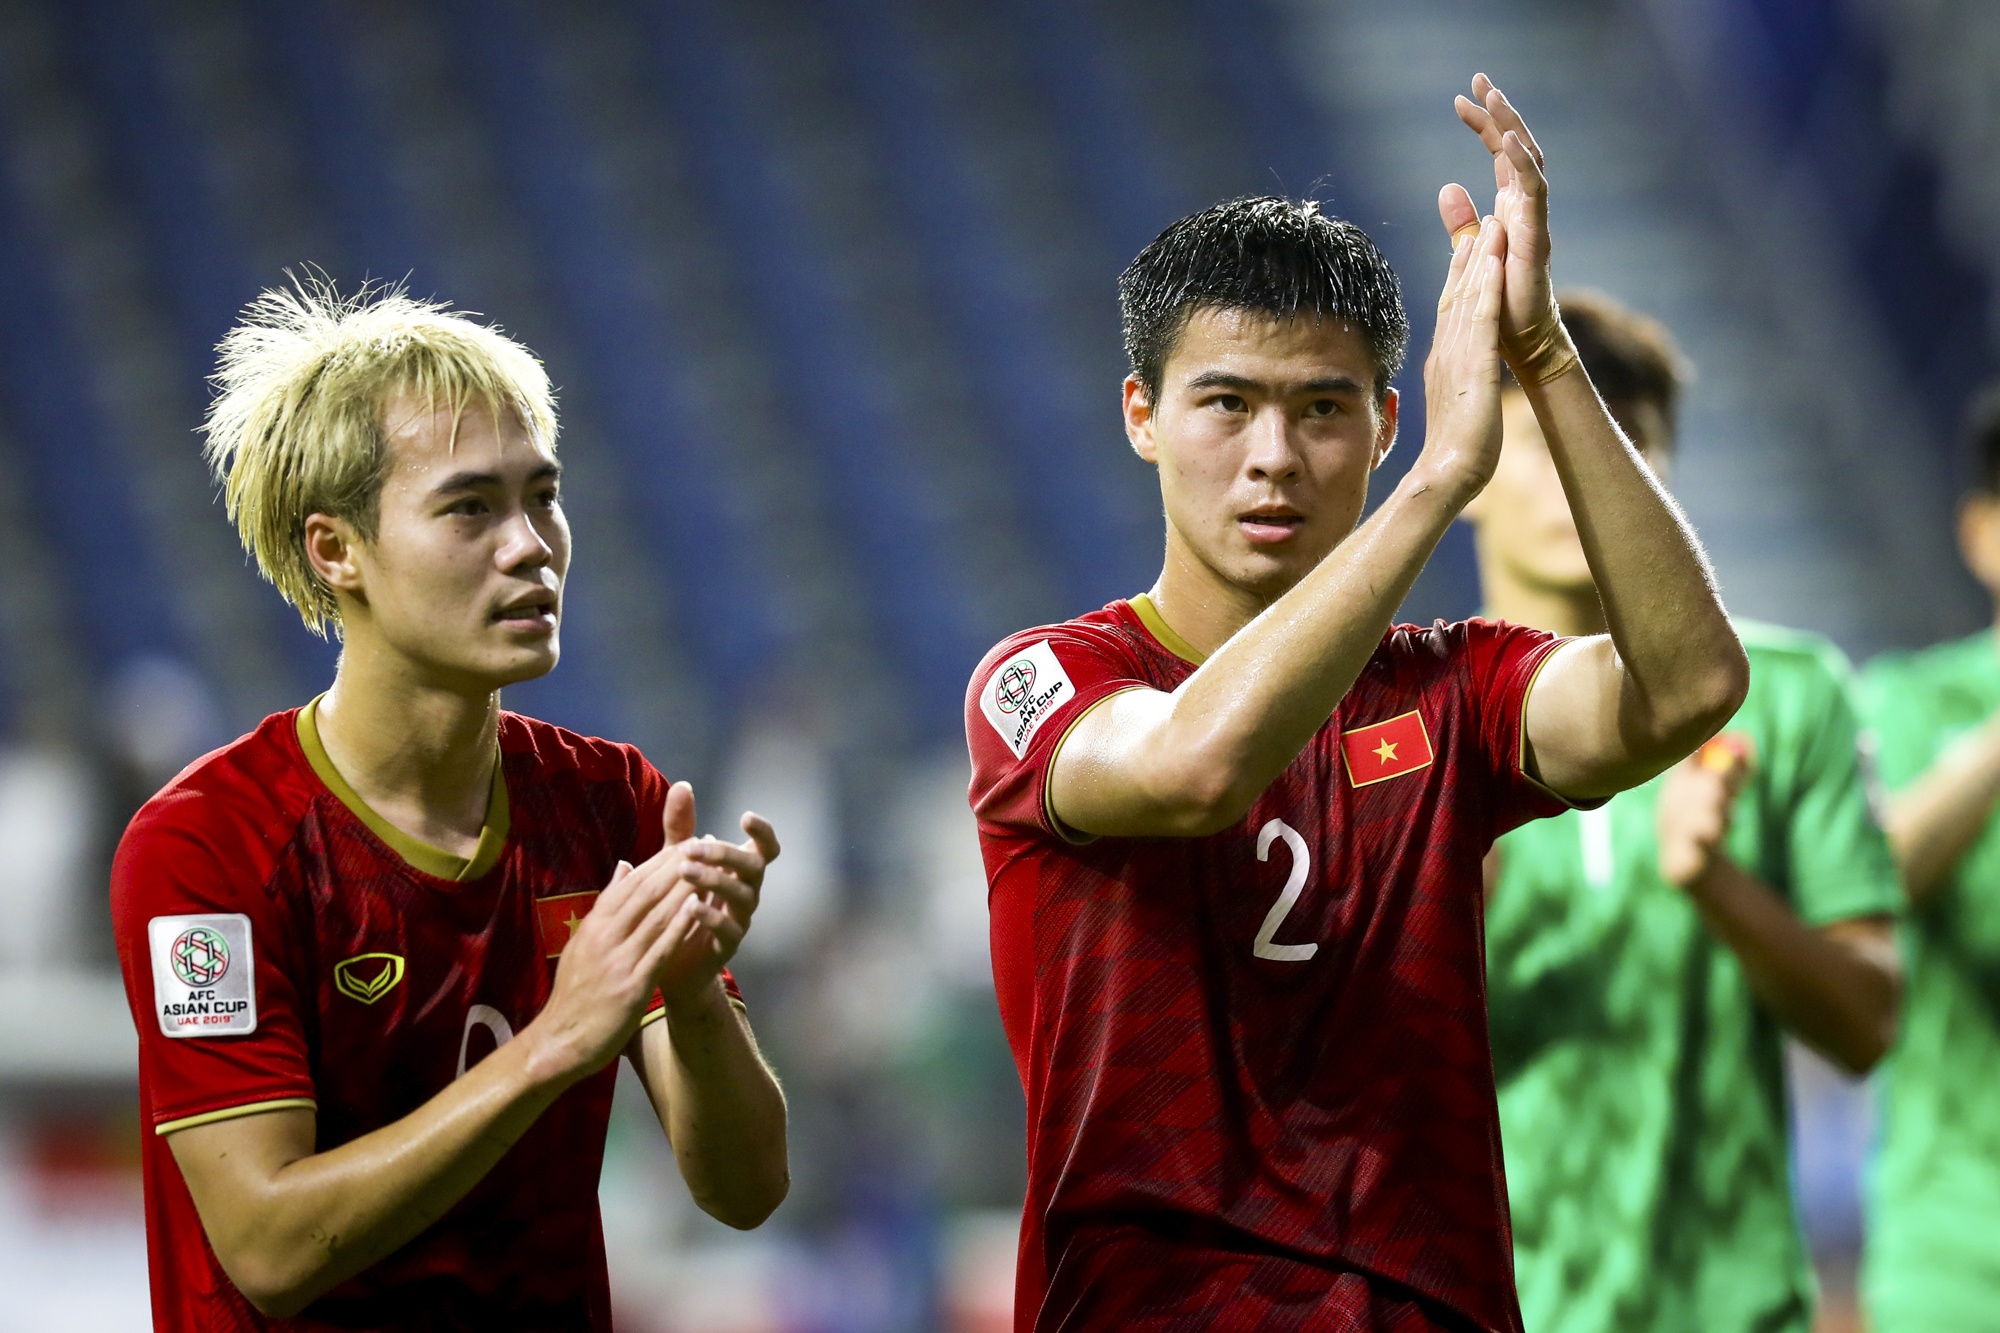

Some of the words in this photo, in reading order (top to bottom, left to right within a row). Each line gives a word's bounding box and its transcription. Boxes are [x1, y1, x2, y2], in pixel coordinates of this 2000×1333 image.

[1014, 706, 1037, 751] ASIAN
[1036, 681, 1063, 707] CUP
[1019, 694, 1036, 719] AFC
[1022, 724, 1034, 743] UAE
[1253, 818, 1318, 962] 2
[188, 990, 215, 1000] AFC
[163, 1003, 208, 1015] ASIAN
[214, 1001, 247, 1013] CUP
[177, 1016, 199, 1025] UAE
